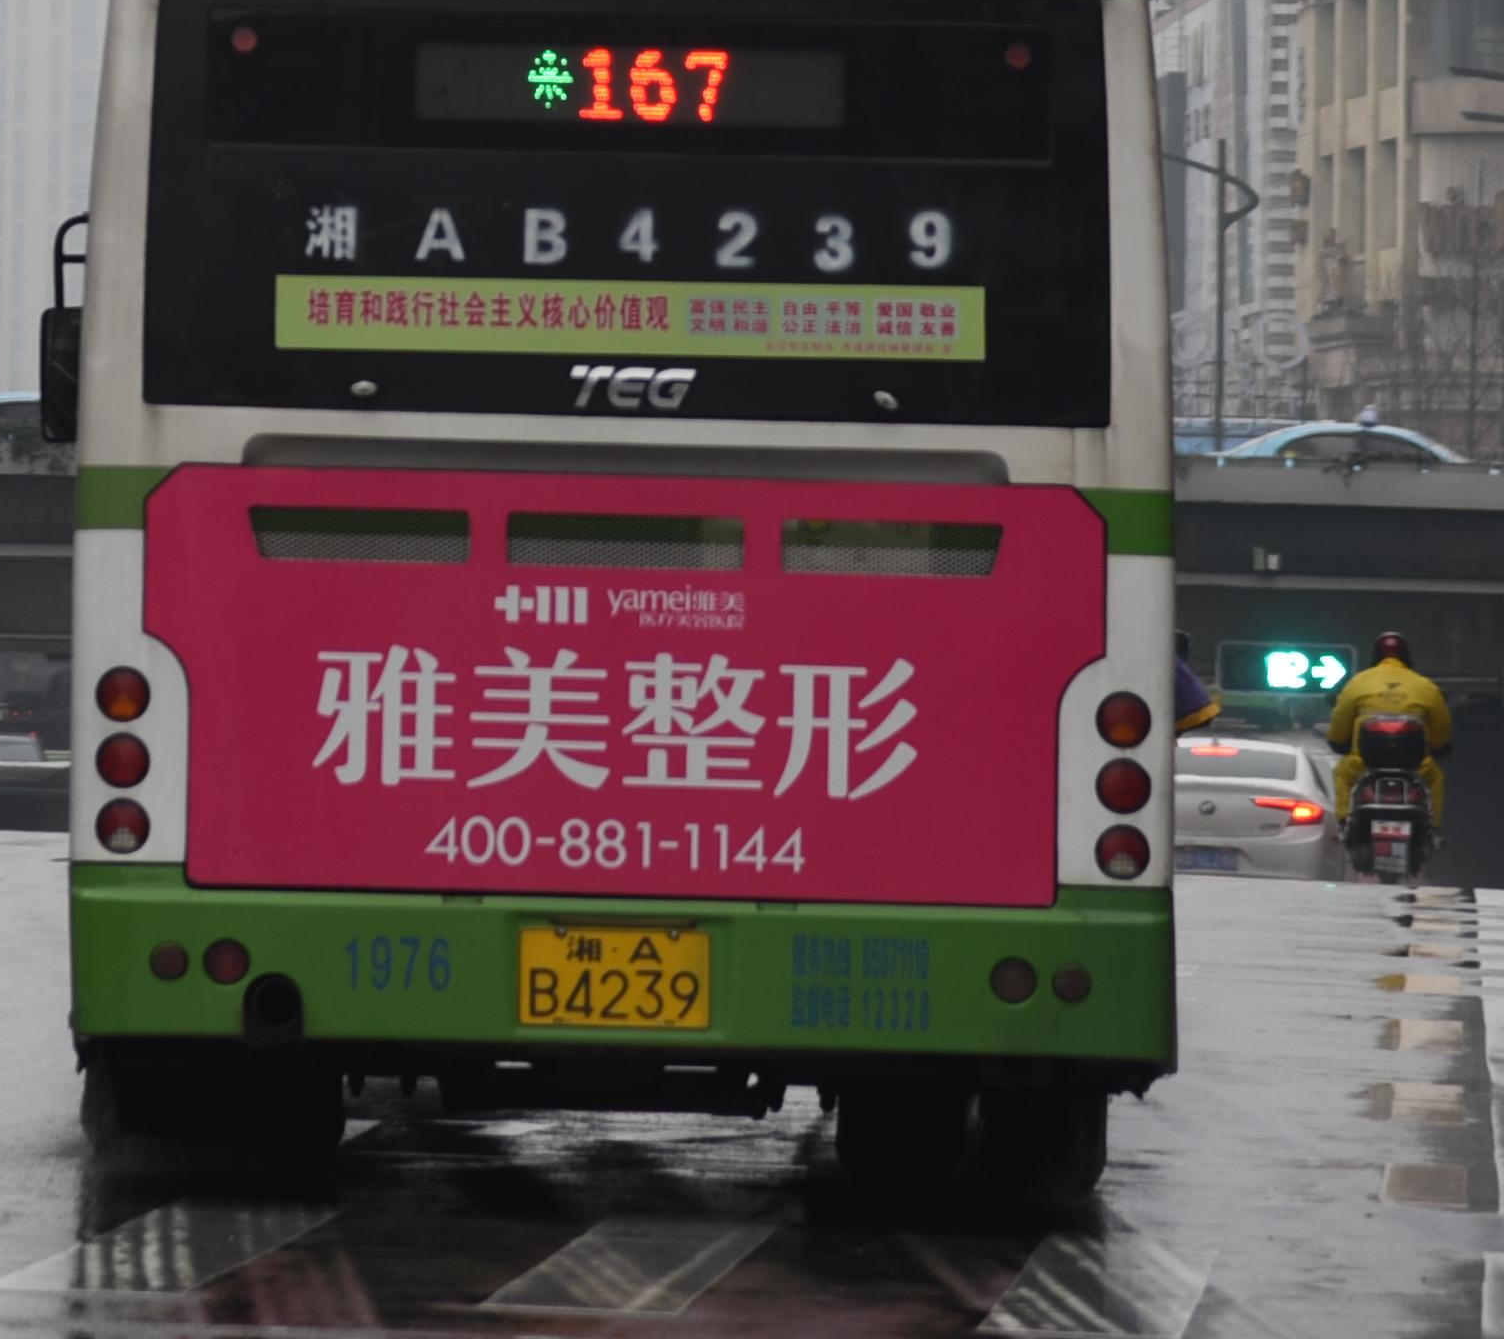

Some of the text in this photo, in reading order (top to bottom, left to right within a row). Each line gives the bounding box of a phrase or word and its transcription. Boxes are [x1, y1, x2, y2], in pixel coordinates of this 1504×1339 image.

[578, 47, 732, 122] 167
[307, 287, 671, 333] 培育和践行社会主义核心价值观
[312, 645, 920, 802] 雅美整形
[423, 814, 807, 876] 400-881-1144
[344, 935, 453, 992] 1976
[528, 966, 700, 1021] B4239
